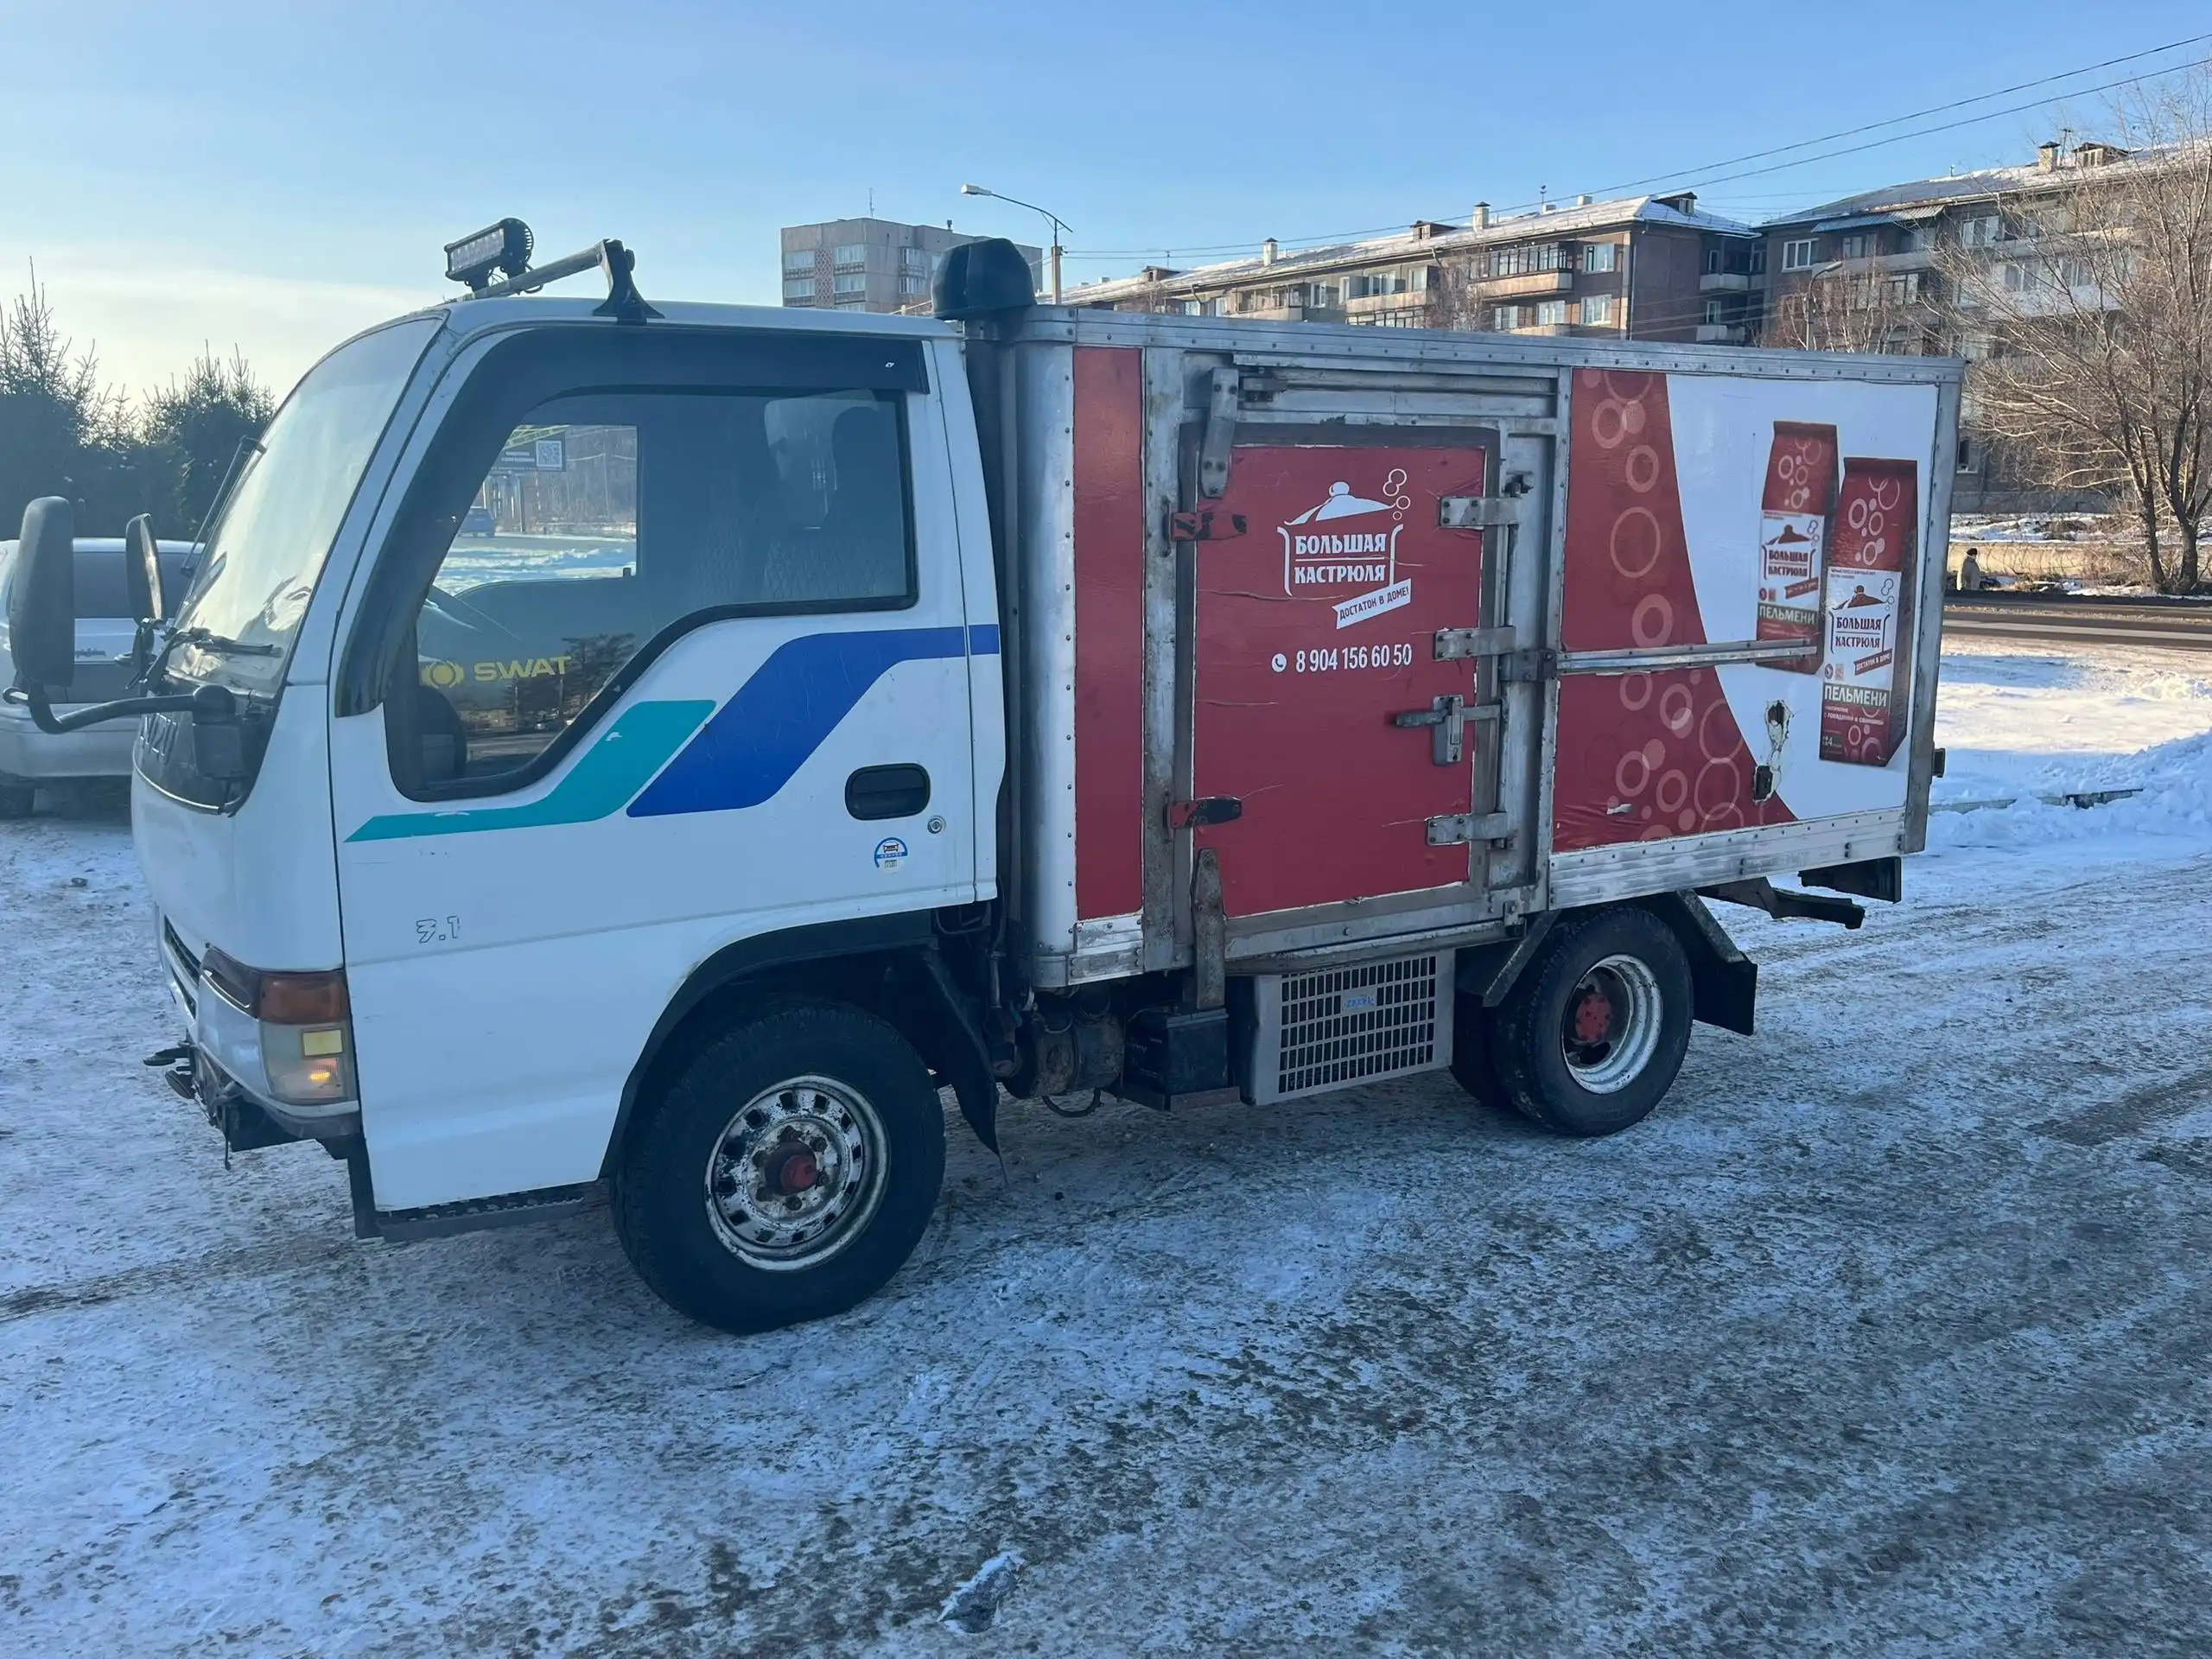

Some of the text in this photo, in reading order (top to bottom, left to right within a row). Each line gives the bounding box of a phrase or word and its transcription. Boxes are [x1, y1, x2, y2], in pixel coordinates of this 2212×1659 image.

[1294, 533, 1388, 555] БОЛЬШАЯ
[1294, 564, 1386, 584] КАСТРЮЛЯ
[1339, 585, 1409, 621] ДОСТАТОК В ДОМЕ!
[1759, 605, 1815, 625] ПЕЛЬМЕНИ
[1836, 616, 1882, 631] БОЛЬШАЯ
[1835, 636, 1880, 648] КАСТРЮЛЯ
[474, 656, 572, 682] SWAT
[1295, 643, 1413, 673] 8 904 156 60 50
[1824, 684, 1887, 708] ПЕЛЬМЕНИ
